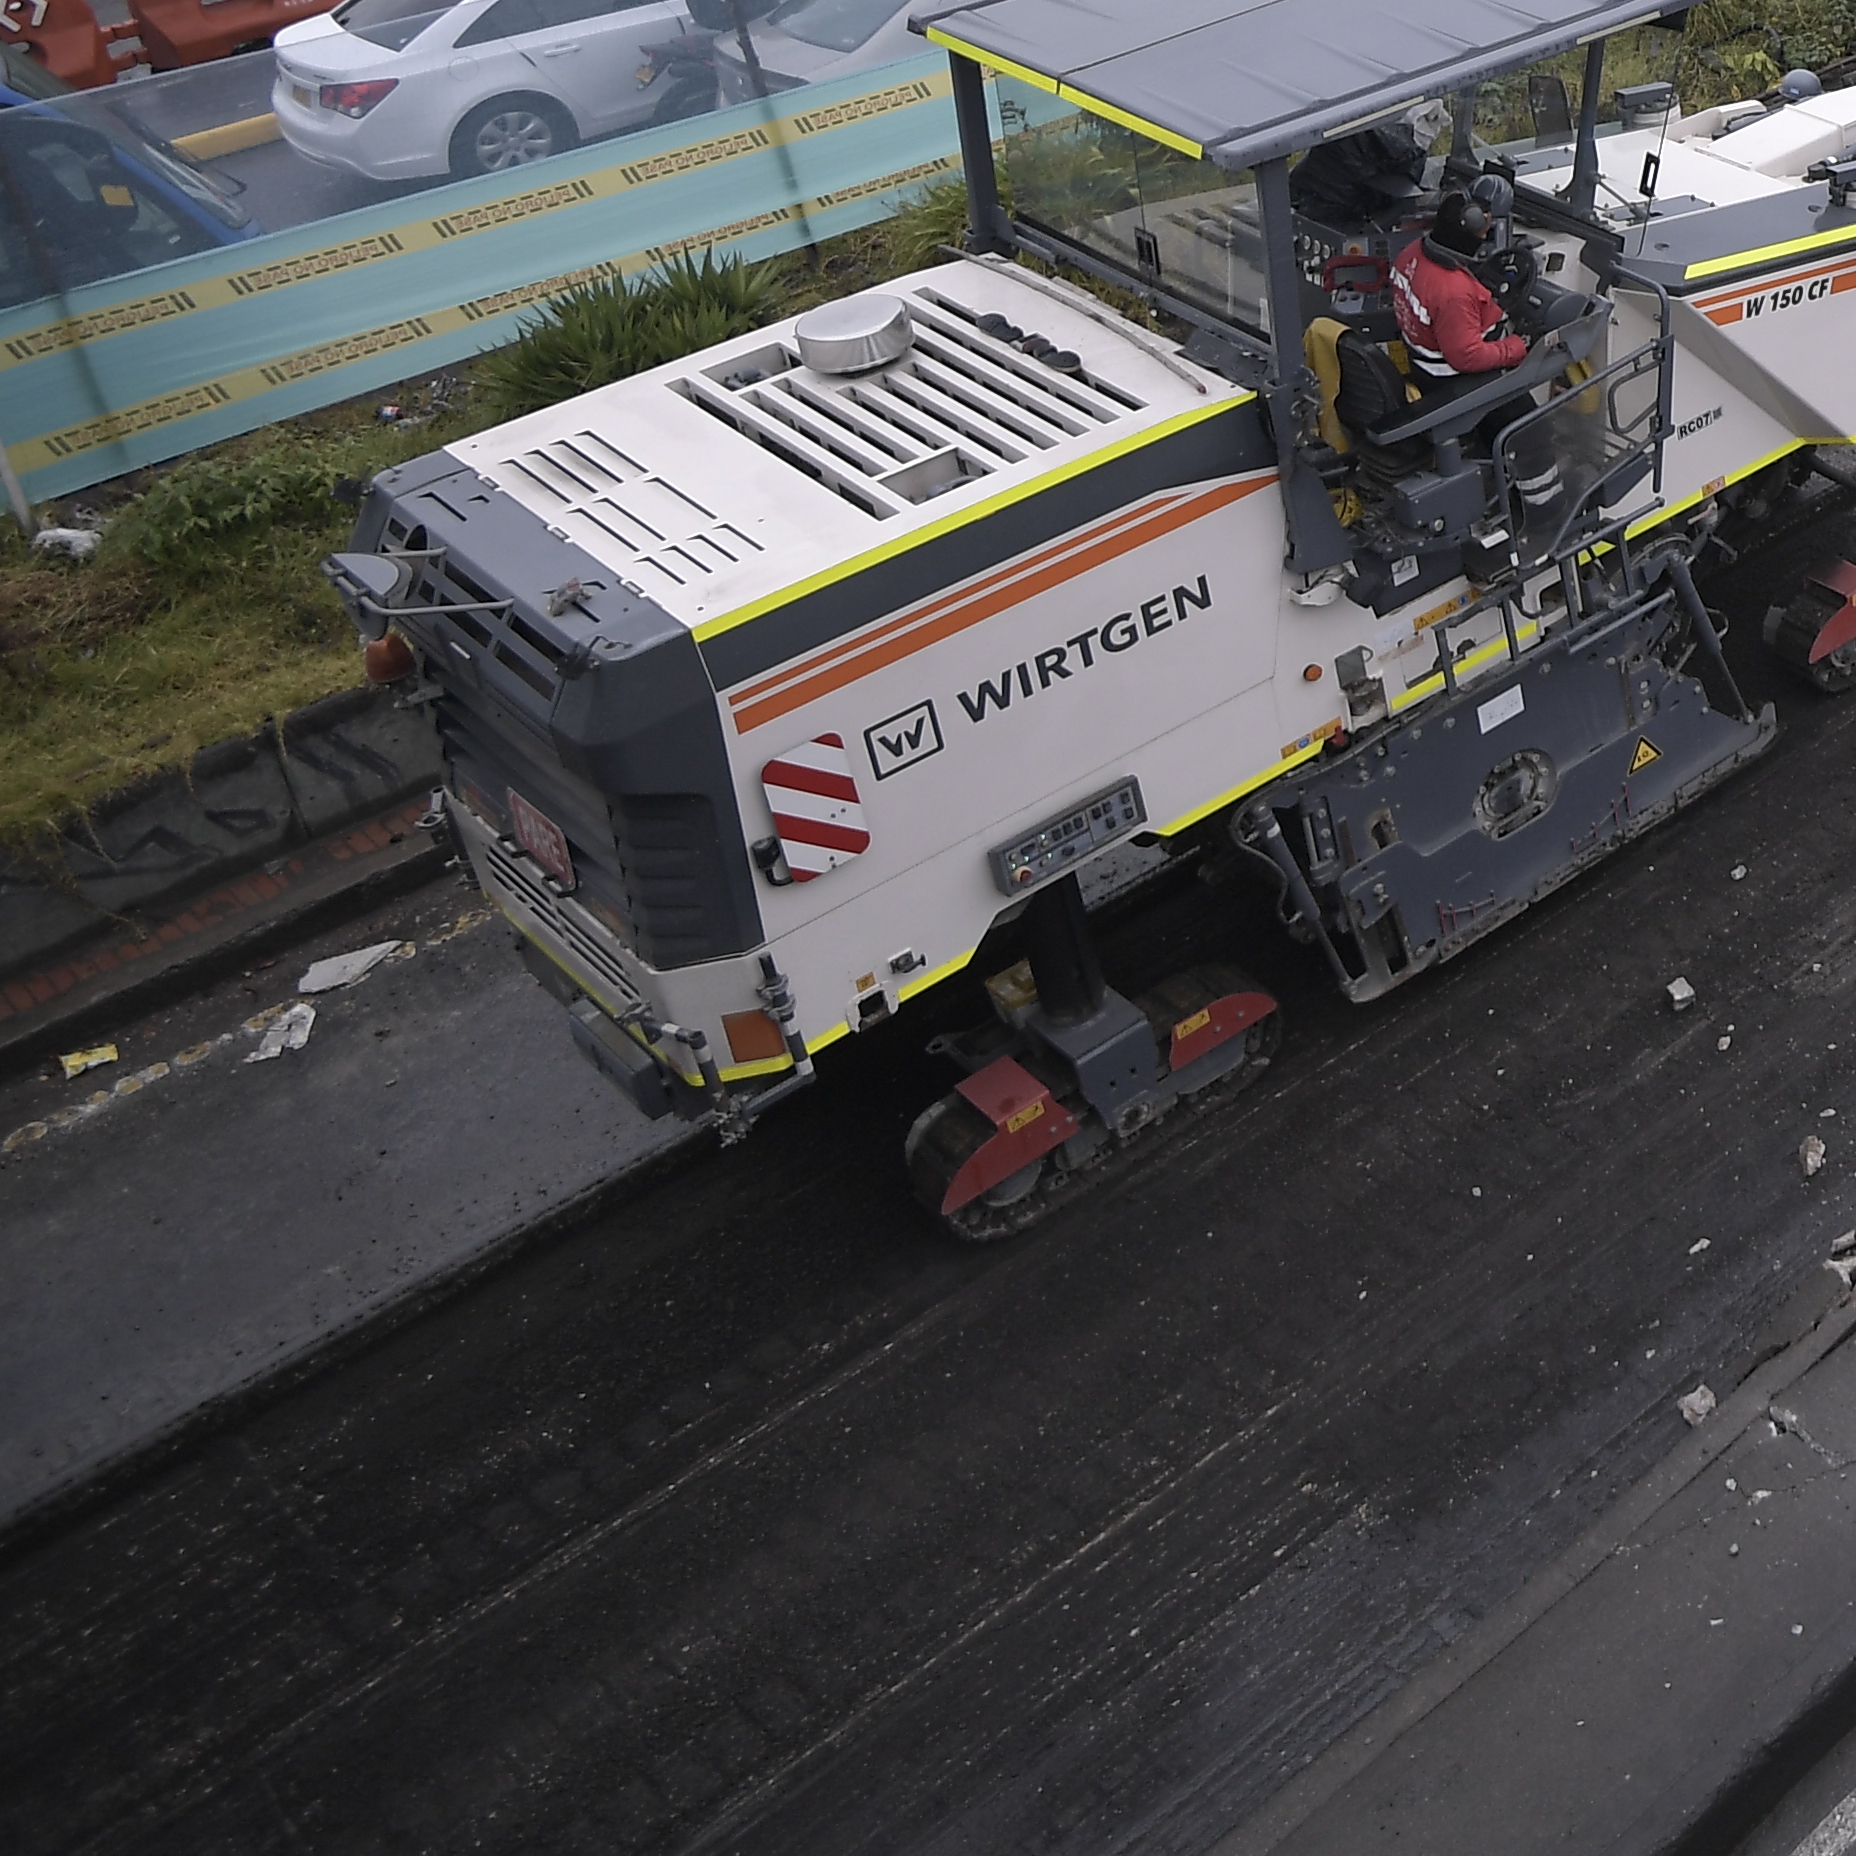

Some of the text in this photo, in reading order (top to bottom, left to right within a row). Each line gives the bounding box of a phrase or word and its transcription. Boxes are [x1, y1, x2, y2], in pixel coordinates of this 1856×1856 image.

[1744, 278, 1830, 319] W 150 CF
[1680, 414, 1713, 439] RC07
[956, 573, 1213, 724] WIRTGEN
[519, 806, 565, 872] PARE
